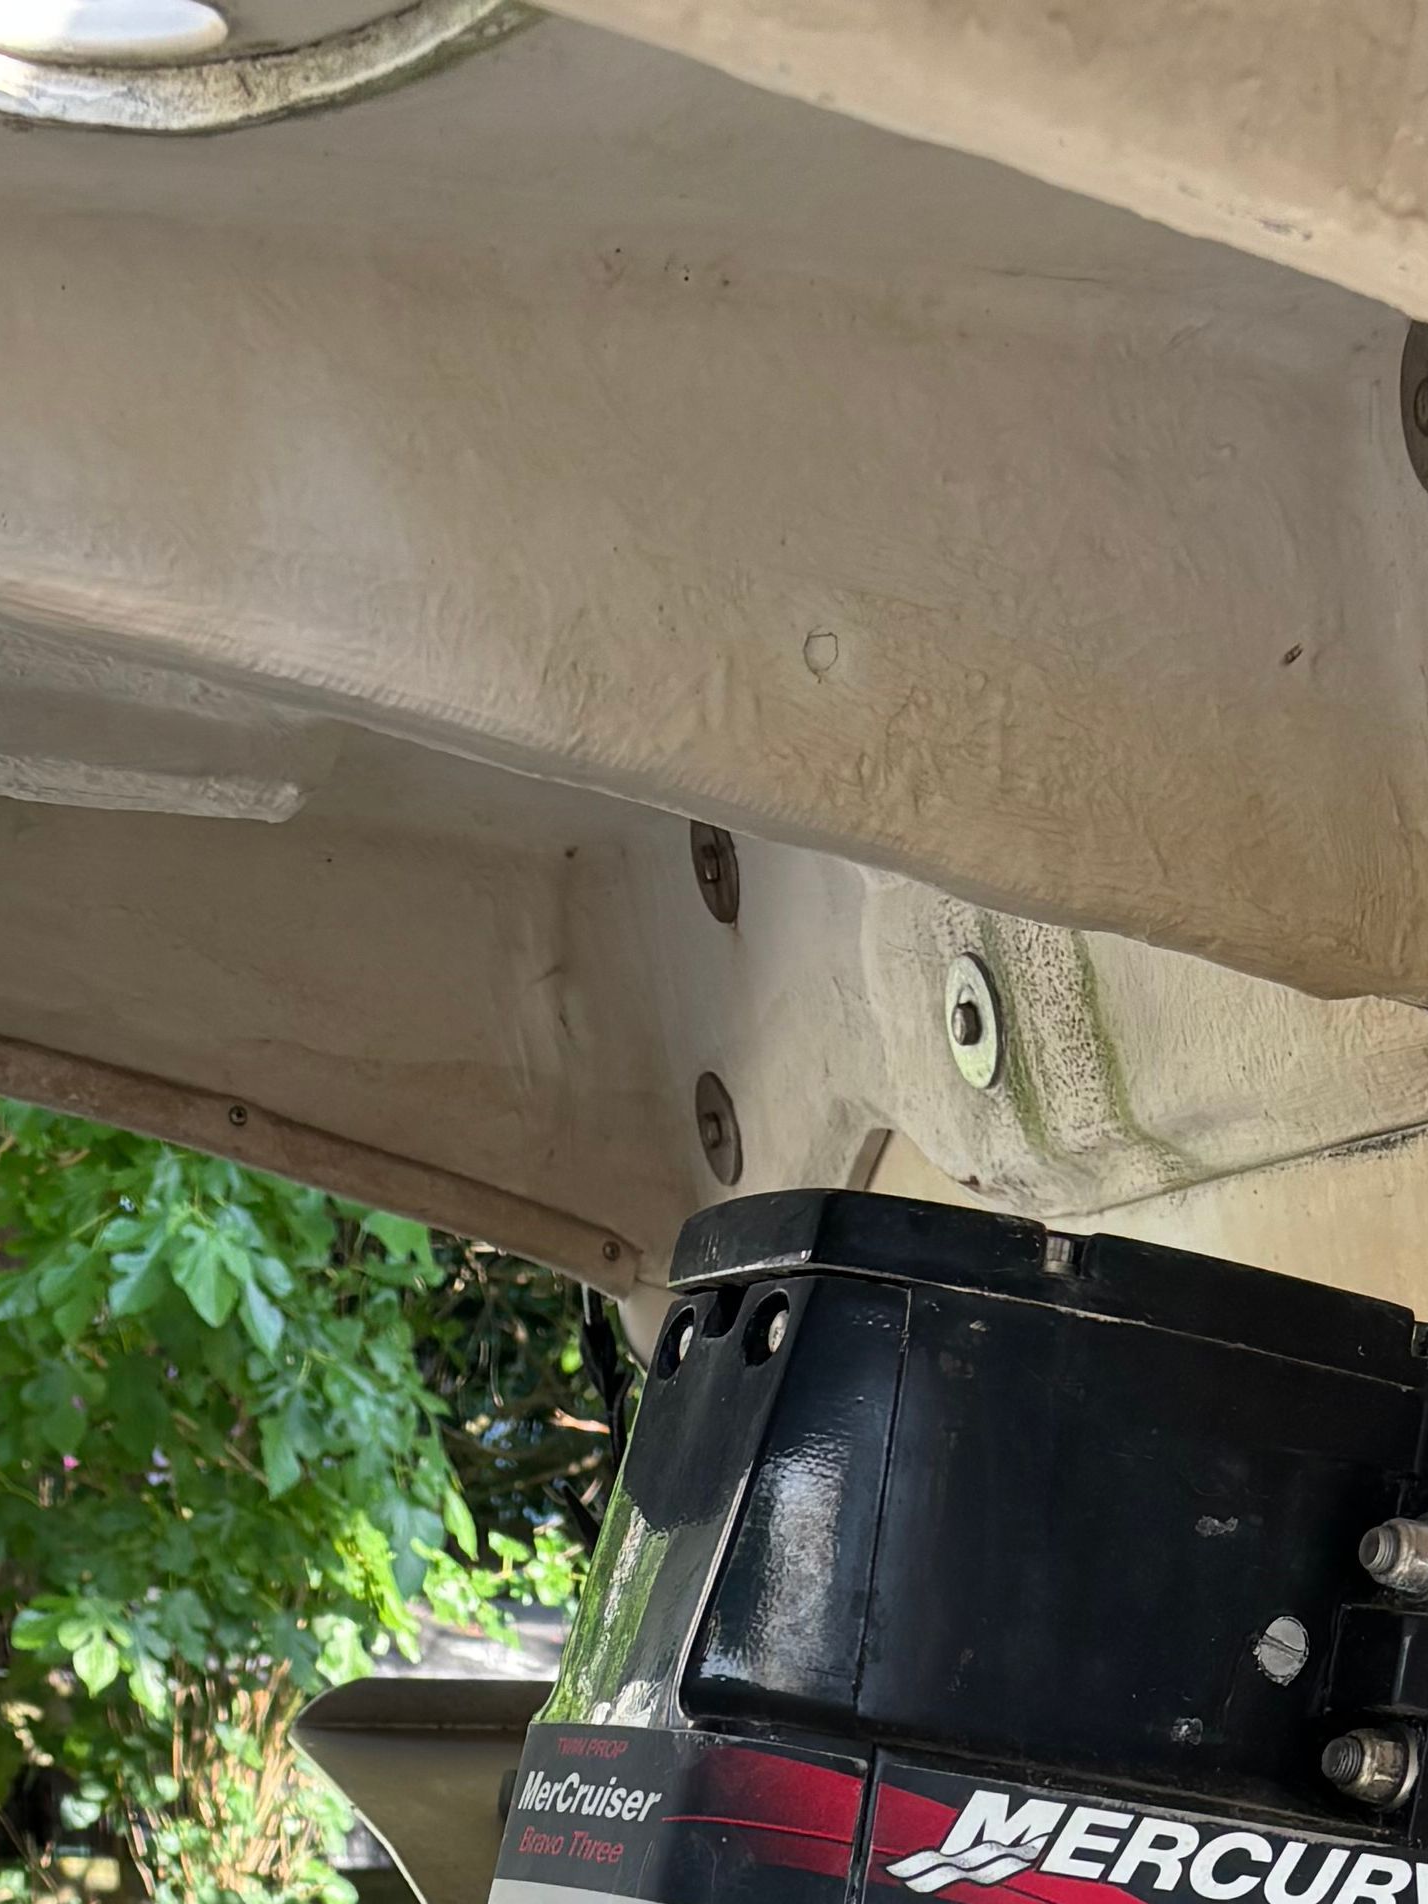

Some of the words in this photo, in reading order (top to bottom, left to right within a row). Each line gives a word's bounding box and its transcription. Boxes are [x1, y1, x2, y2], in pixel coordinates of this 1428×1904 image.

[558, 1738, 586, 1755] TWIN
[586, 1739, 629, 1758] PROP
[517, 1770, 663, 1822] MerCruiser
[518, 1826, 565, 1856] Bravo
[568, 1830, 625, 1864] Three
